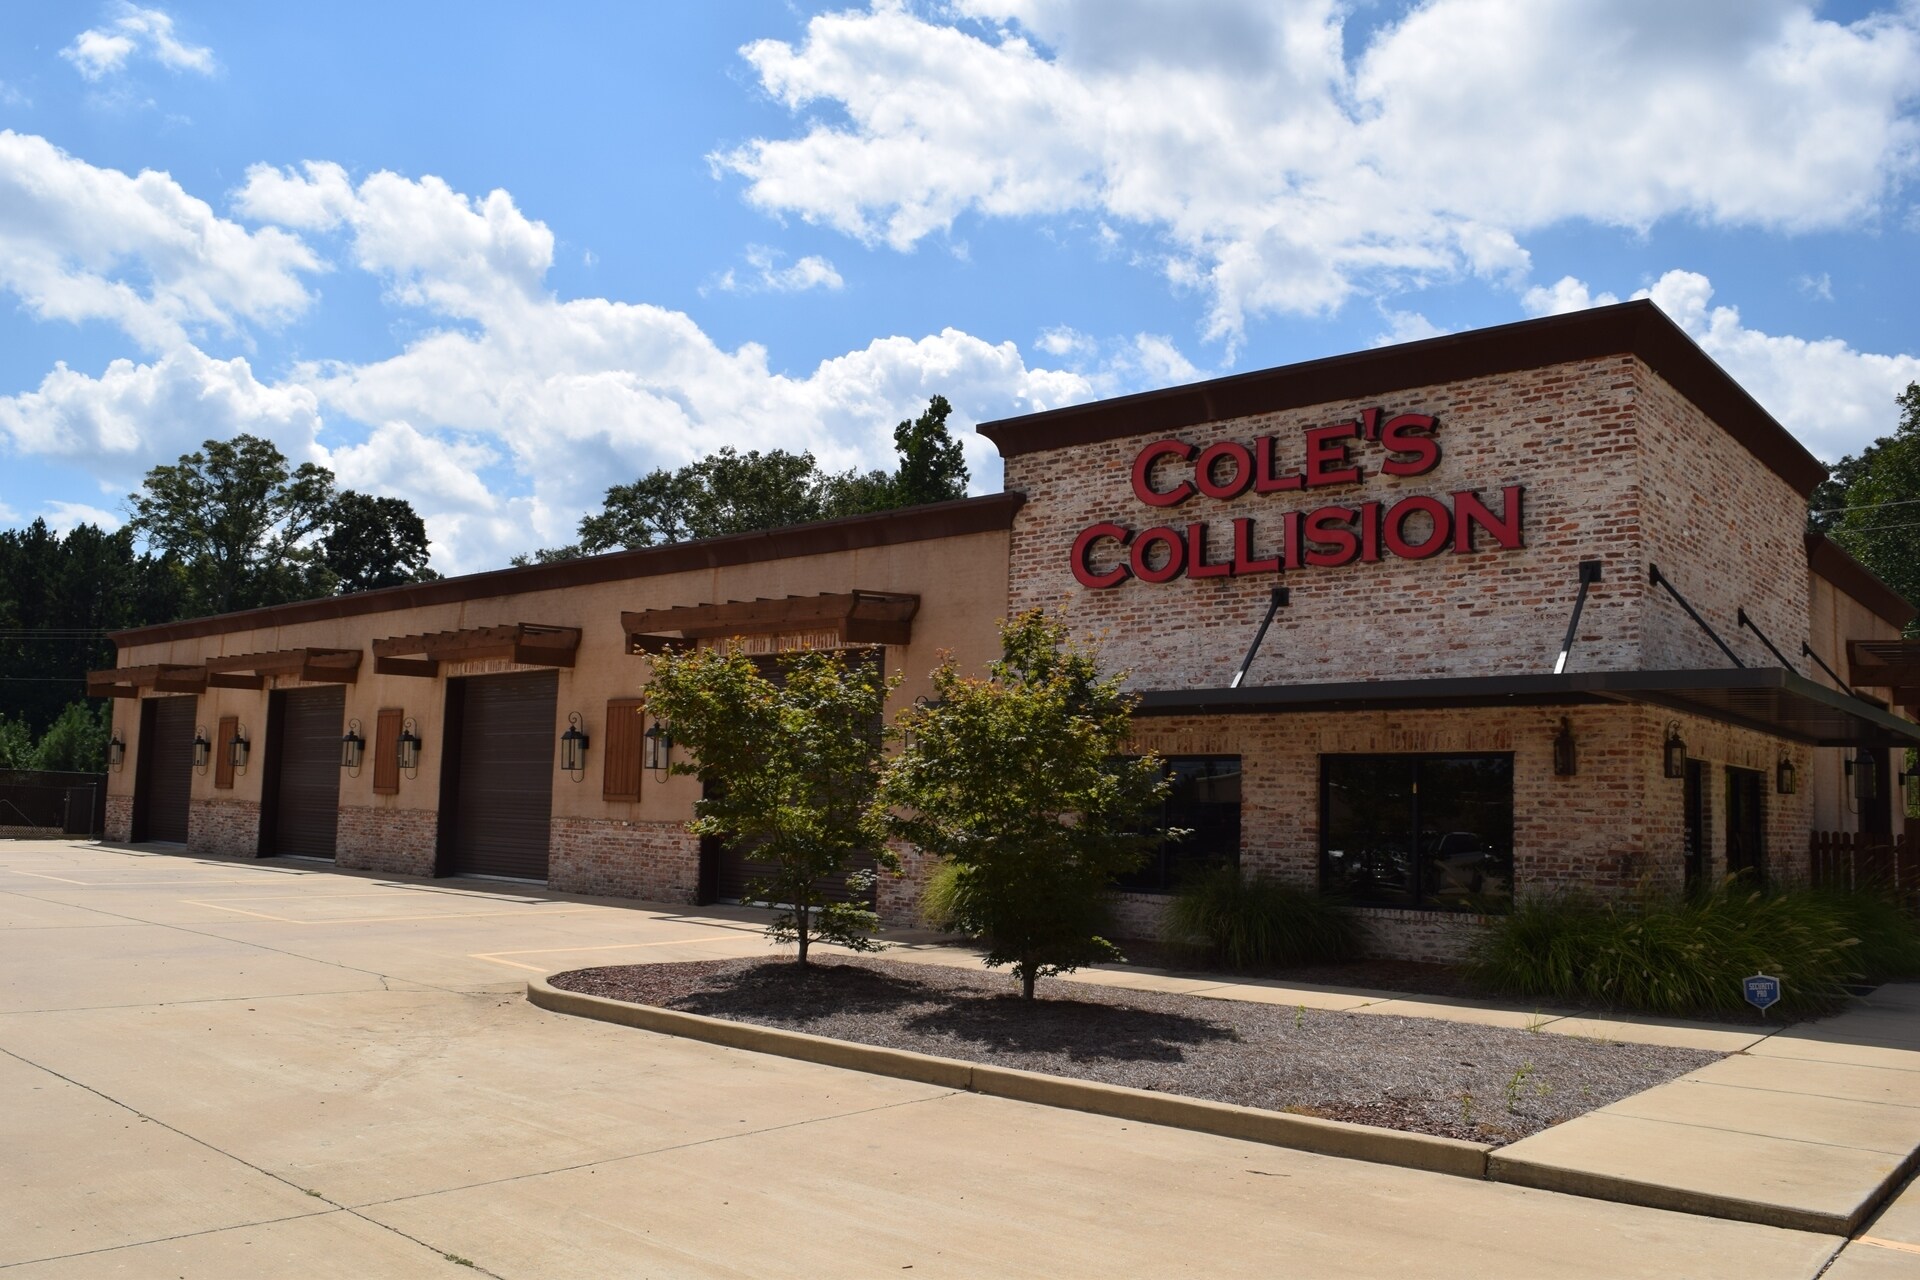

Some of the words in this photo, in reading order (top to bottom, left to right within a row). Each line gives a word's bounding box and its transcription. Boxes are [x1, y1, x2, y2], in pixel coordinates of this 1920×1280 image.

[1131, 407, 1441, 507] COLE'S
[1070, 485, 1525, 589] COLLISION
[1748, 982, 1774, 990] SECURITY
